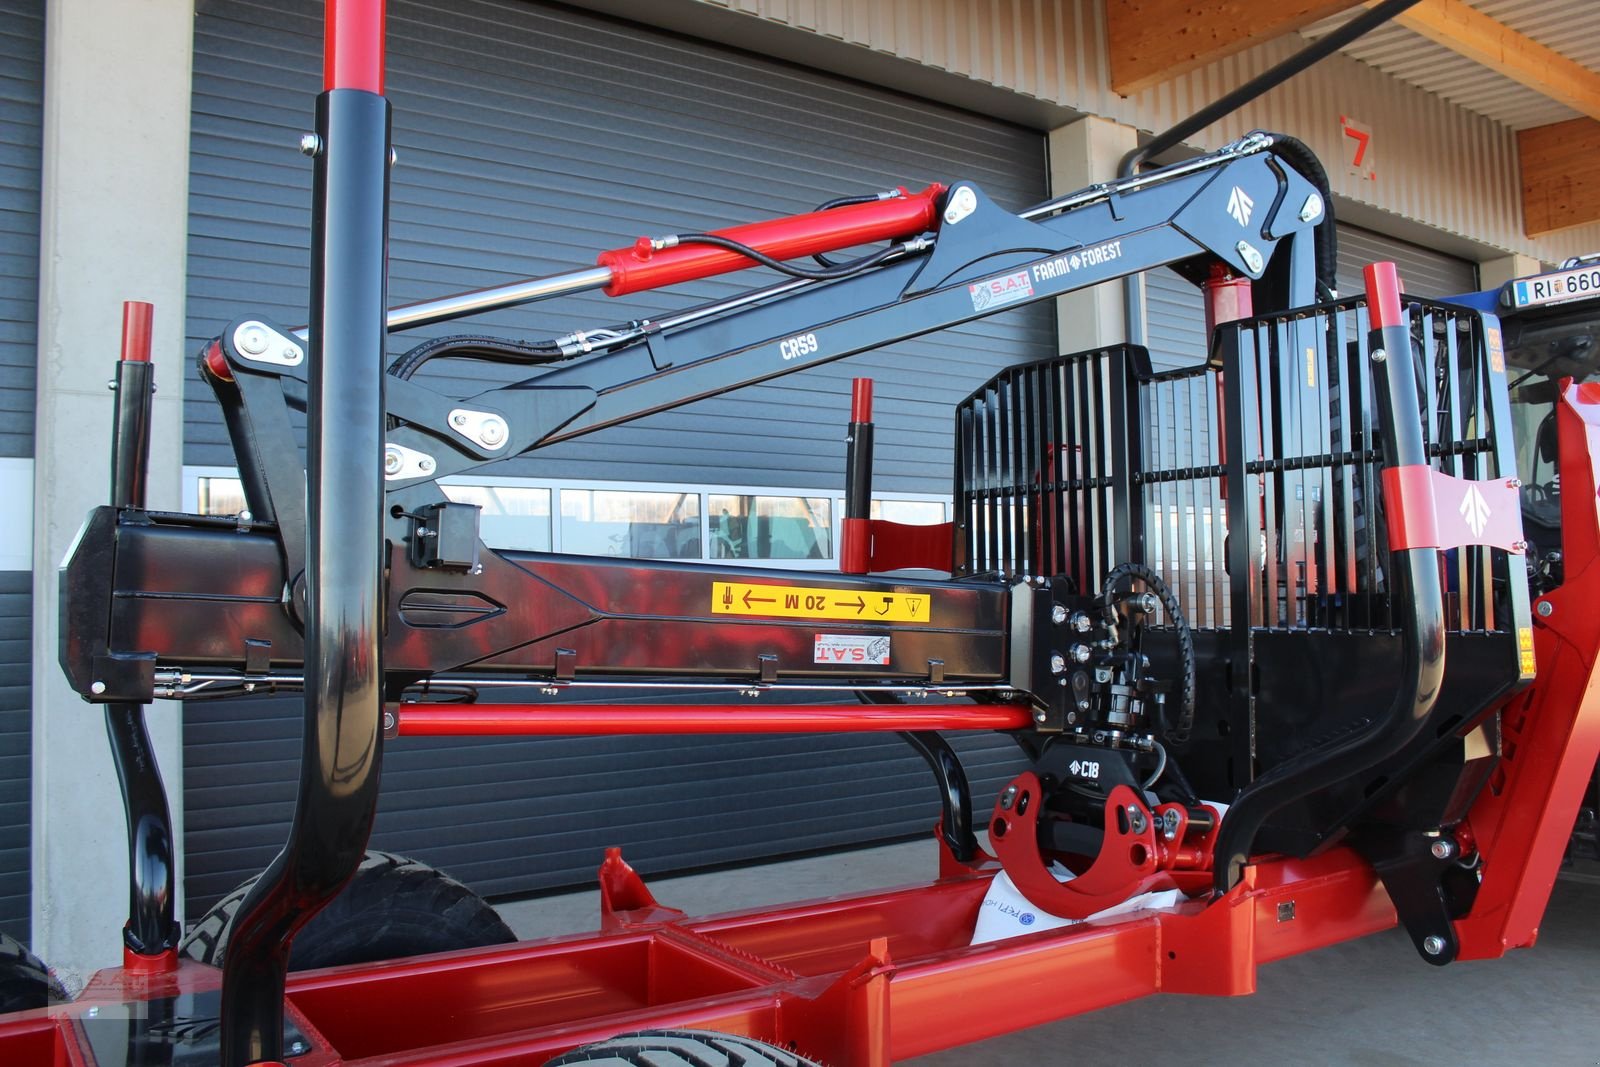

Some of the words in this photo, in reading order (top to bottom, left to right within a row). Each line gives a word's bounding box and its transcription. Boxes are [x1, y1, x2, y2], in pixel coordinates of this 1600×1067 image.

[1344, 126, 1369, 167] 7
[1032, 256, 1071, 283] FARMI
[1081, 241, 1122, 269] FOREST
[990, 273, 1030, 294] S.A.T.
[1534, 280, 1551, 299] RI
[785, 593, 799, 609] M
[805, 595, 826, 611] 20
[816, 646, 865, 661] S.A.T.
[1081, 760, 1099, 778] C18
